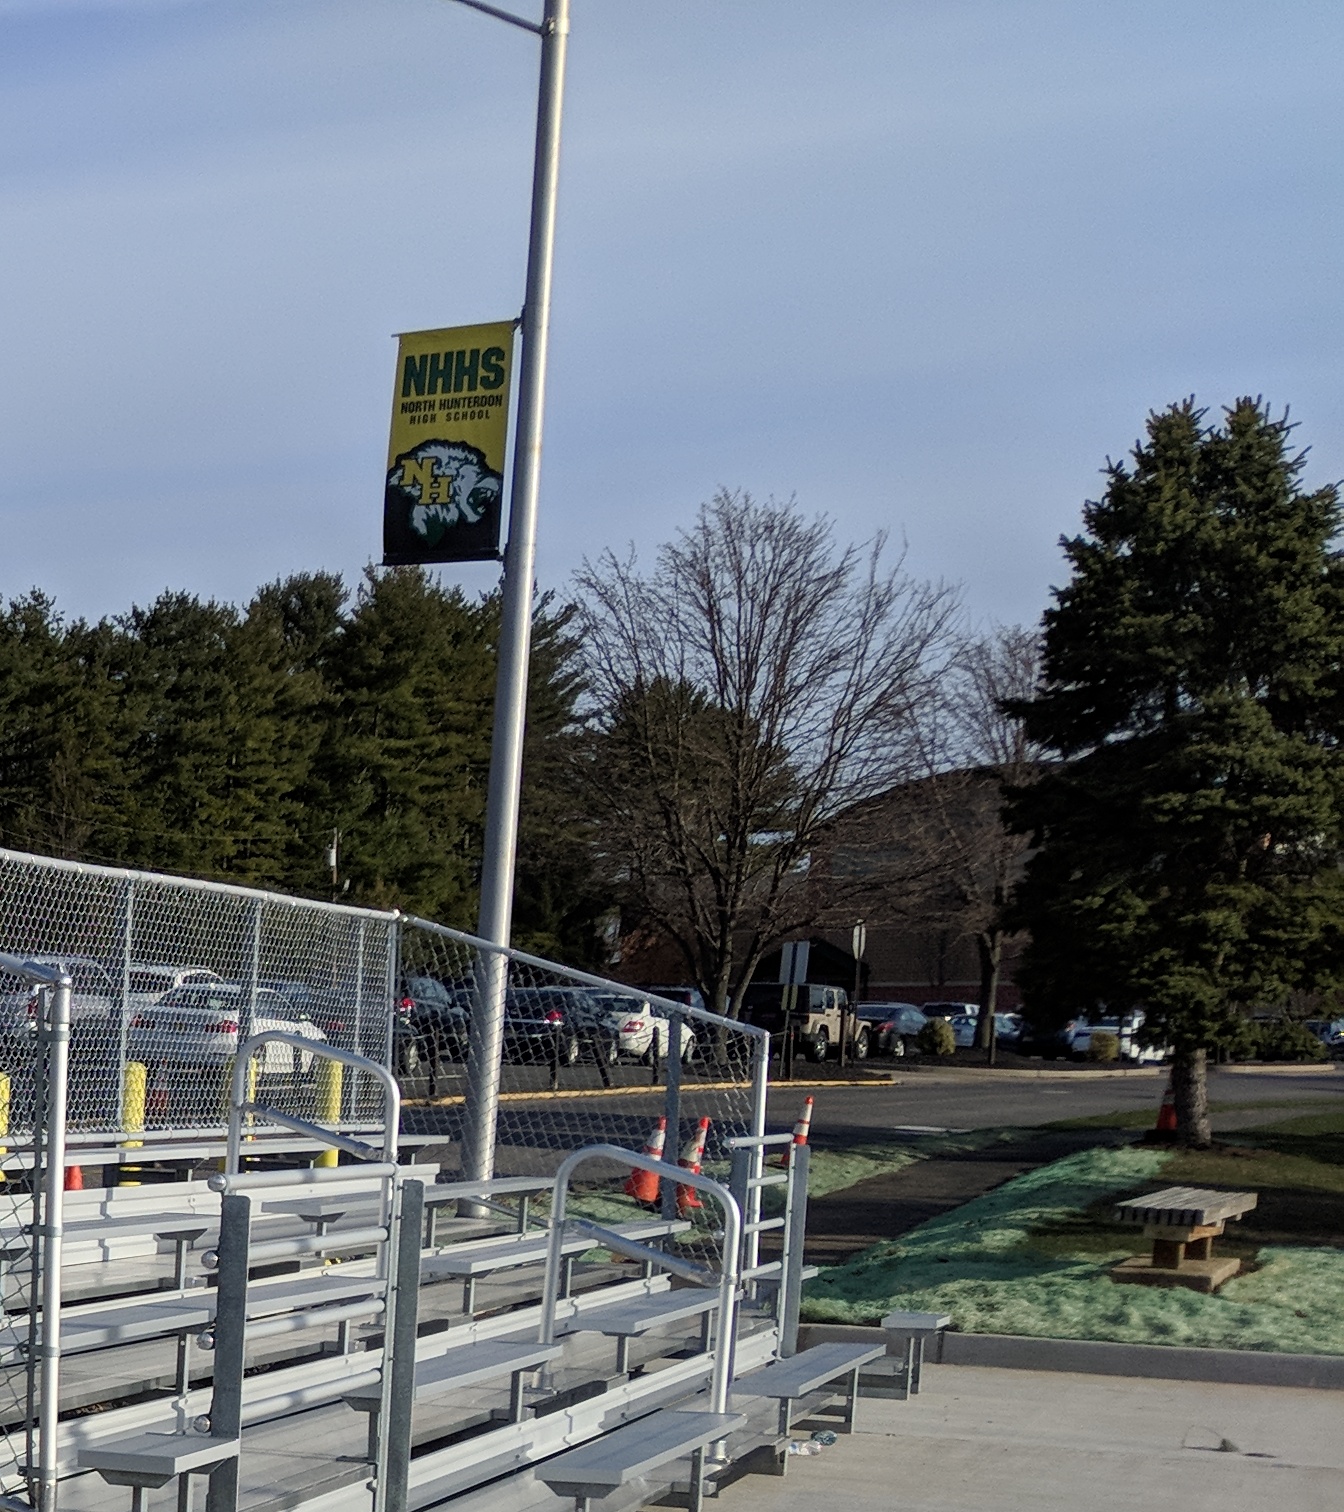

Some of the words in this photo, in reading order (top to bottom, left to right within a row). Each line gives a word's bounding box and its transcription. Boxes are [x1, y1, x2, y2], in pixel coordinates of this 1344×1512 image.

[401, 346, 506, 398] NHHS
[401, 399, 435, 414] NORTH
[439, 395, 503, 411] HUNTERDON
[409, 413, 437, 425] HIGH
[445, 410, 490, 422] SCHOOL
